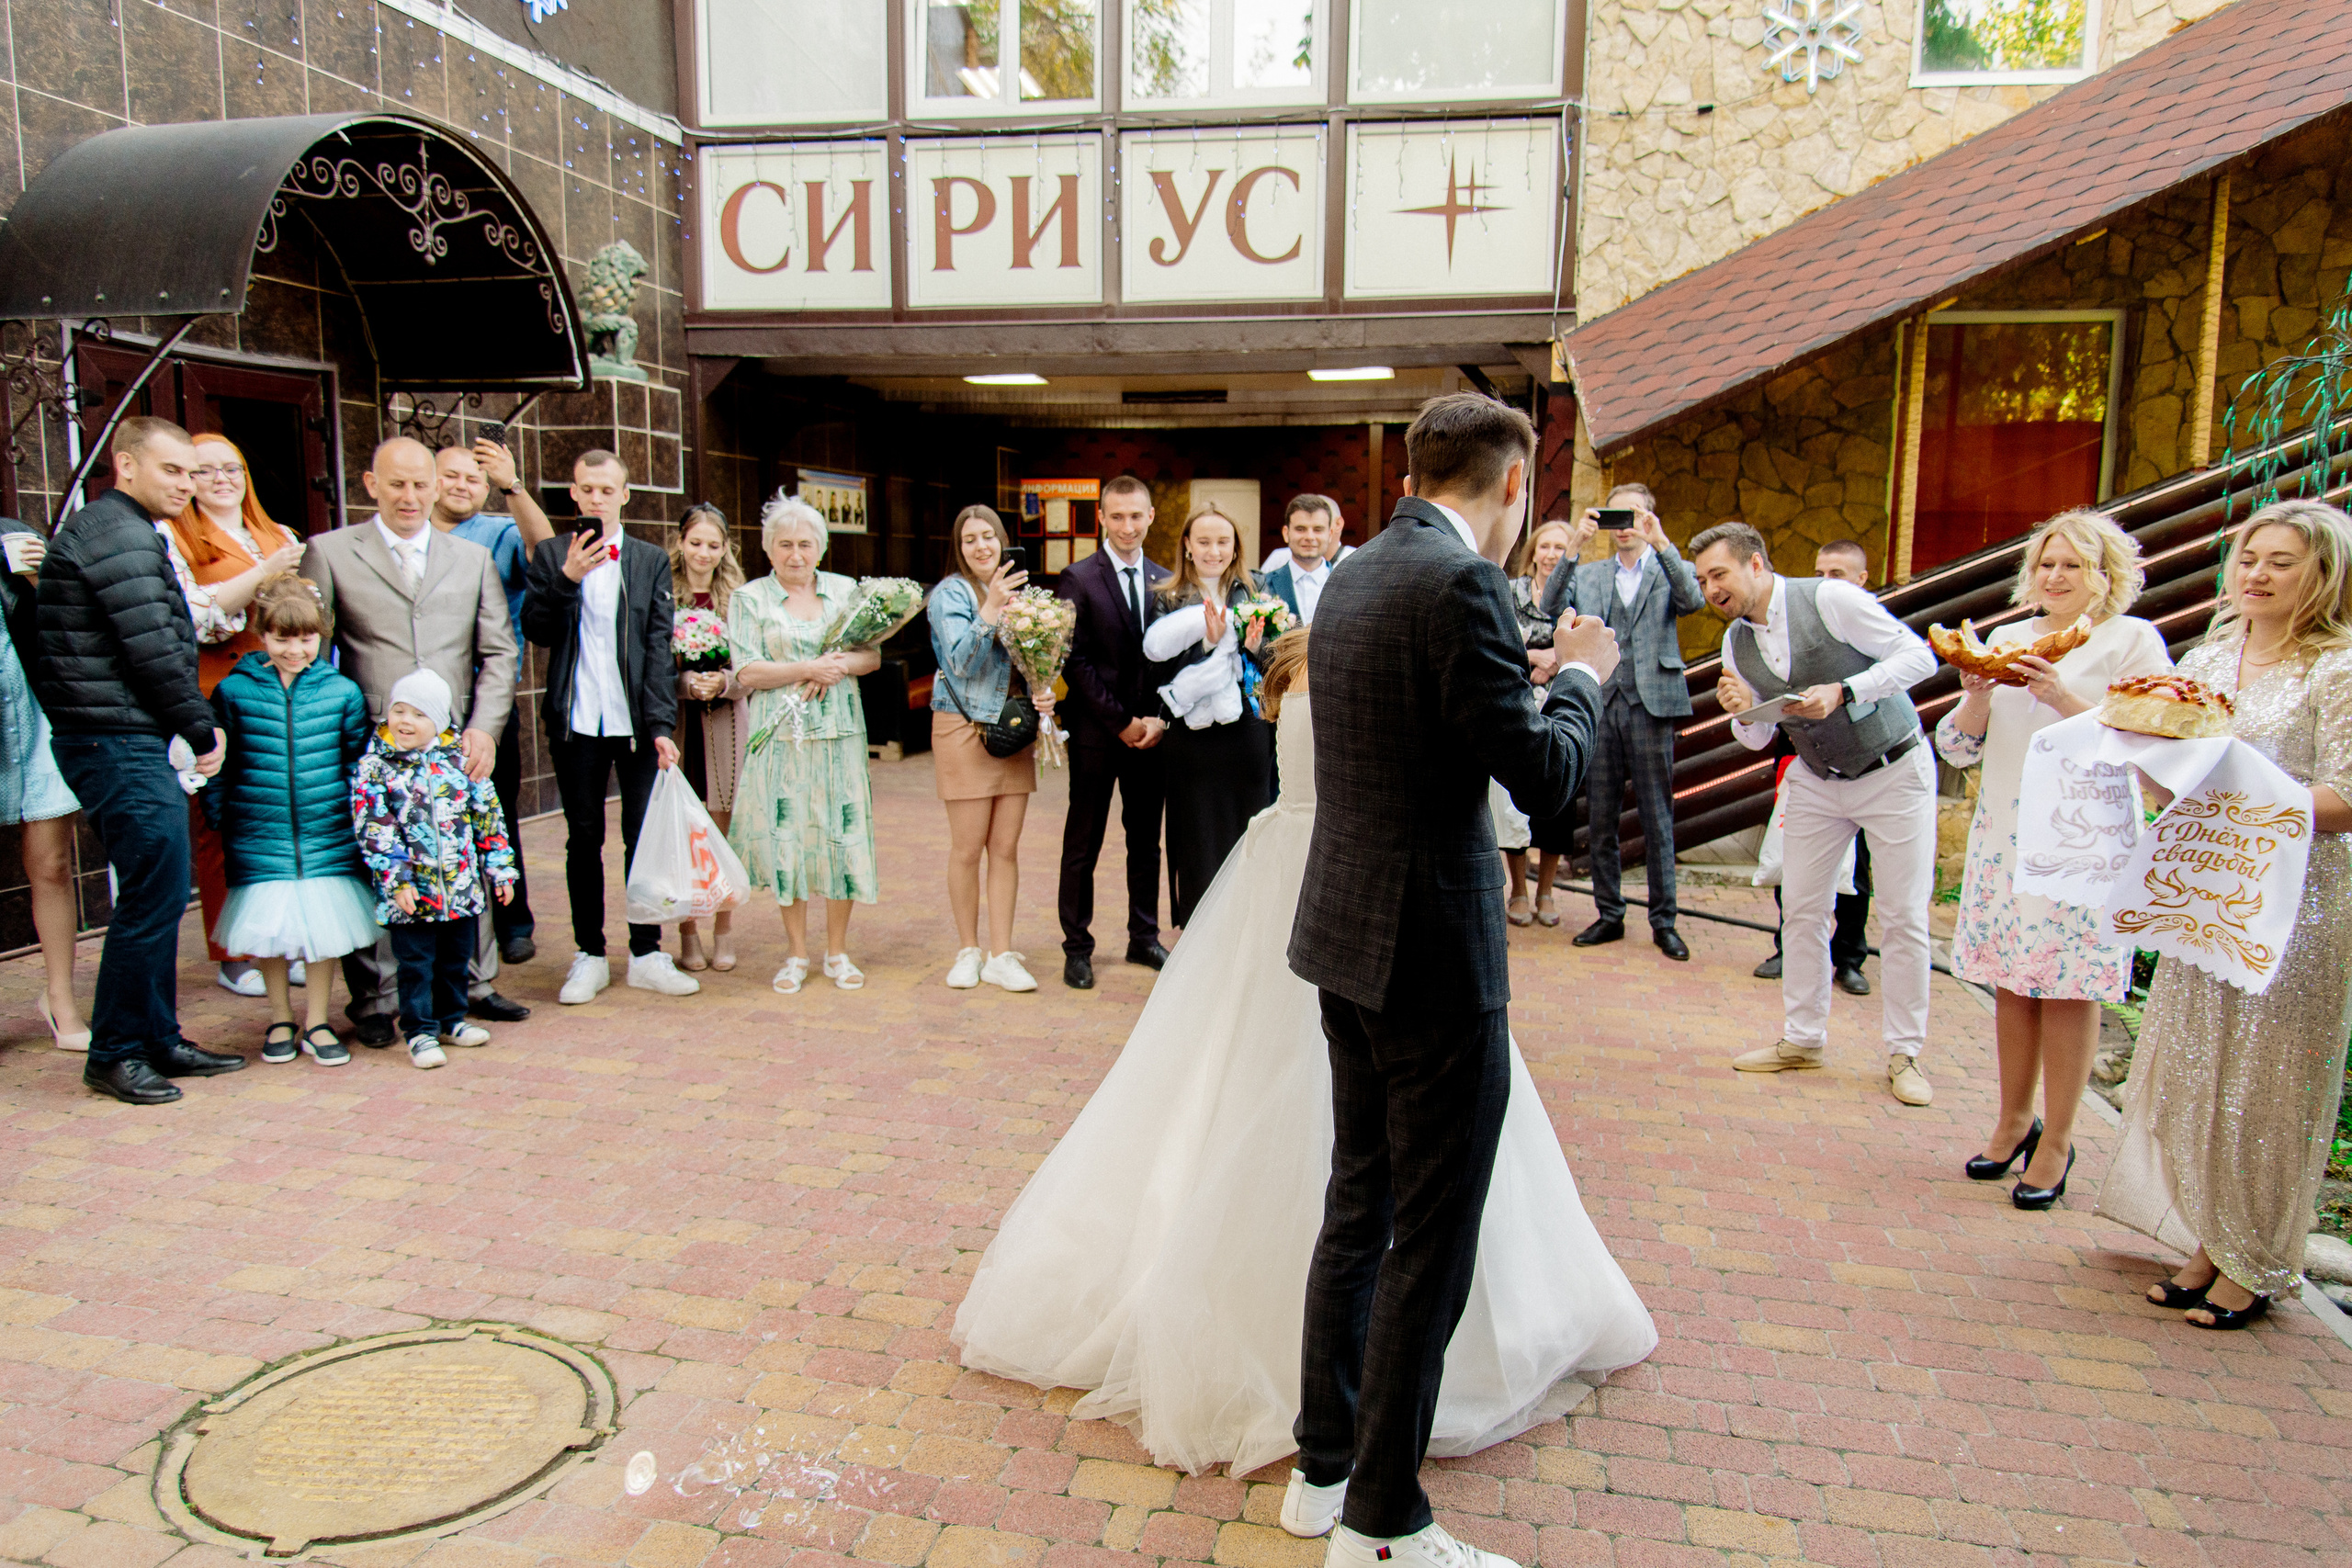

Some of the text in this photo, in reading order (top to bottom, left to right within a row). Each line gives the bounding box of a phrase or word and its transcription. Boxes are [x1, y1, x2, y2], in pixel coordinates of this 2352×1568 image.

[720, 165, 1303, 275] СИРИУС
[1021, 483, 1098, 496] ИНФОРМАЦИЯ
[2175, 820, 2250, 852] Днём
[2151, 842, 2272, 883] свадьбы!
